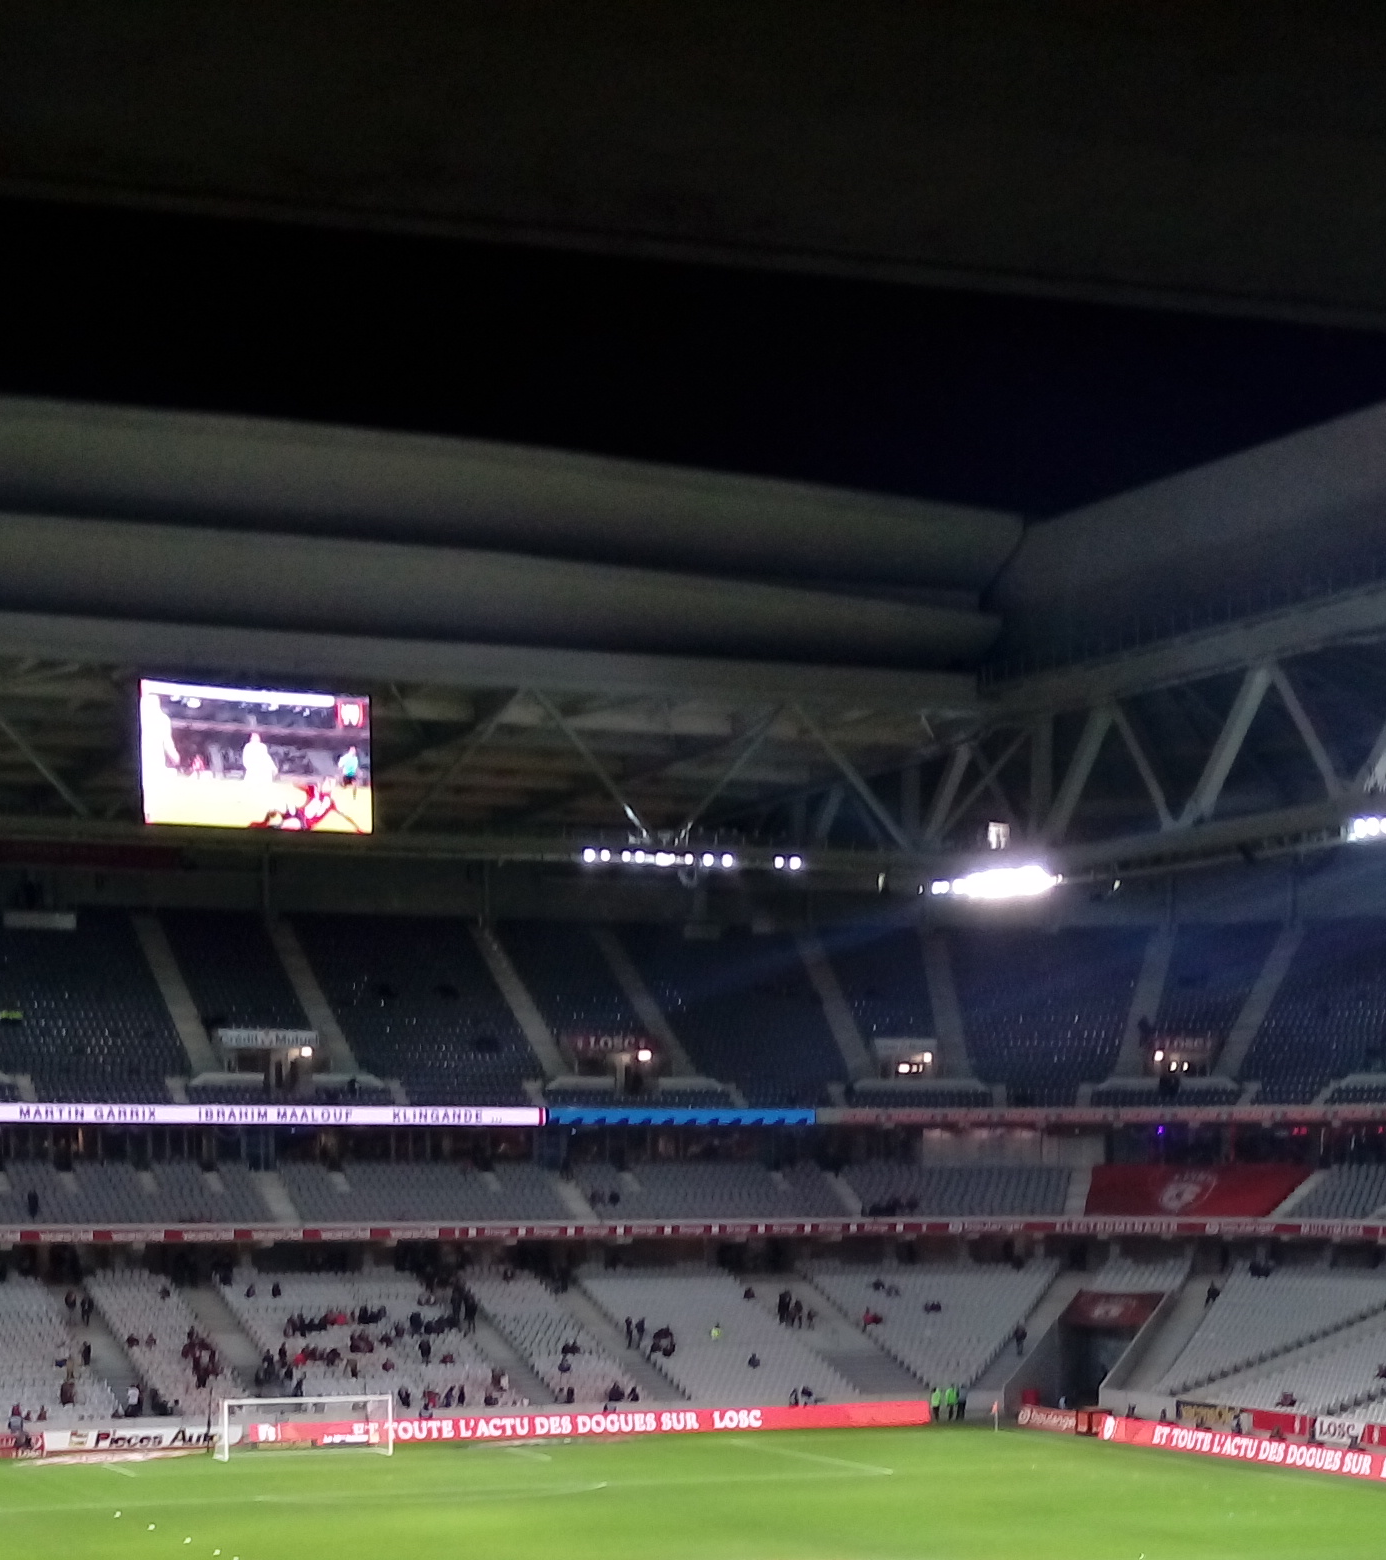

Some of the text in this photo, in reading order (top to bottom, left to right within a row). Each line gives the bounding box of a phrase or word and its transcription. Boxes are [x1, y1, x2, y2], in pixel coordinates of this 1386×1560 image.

[19, 1105, 85, 1121] MARTIN
[93, 1105, 157, 1121] GARRIX
[198, 1106, 269, 1123] IBRAHIM
[277, 1106, 353, 1123] MAALOUF
[384, 1417, 455, 1441] TOUTE
[460, 1415, 529, 1438] L'ACTU
[534, 1414, 573, 1437] DES
[577, 1411, 657, 1435] DOGUES
[660, 1409, 700, 1432] SUR
[712, 1407, 764, 1429] LOSC
[1318, 1419, 1356, 1440] LOSC
[1152, 1425, 1171, 1445] ET
[1170, 1427, 1213, 1452] TOUTE
[1211, 1434, 1259, 1458] L'ACTU
[1258, 1440, 1286, 1463] DES
[1285, 1444, 1343, 1472] DOGUES
[1342, 1452, 1372, 1476] SUR
